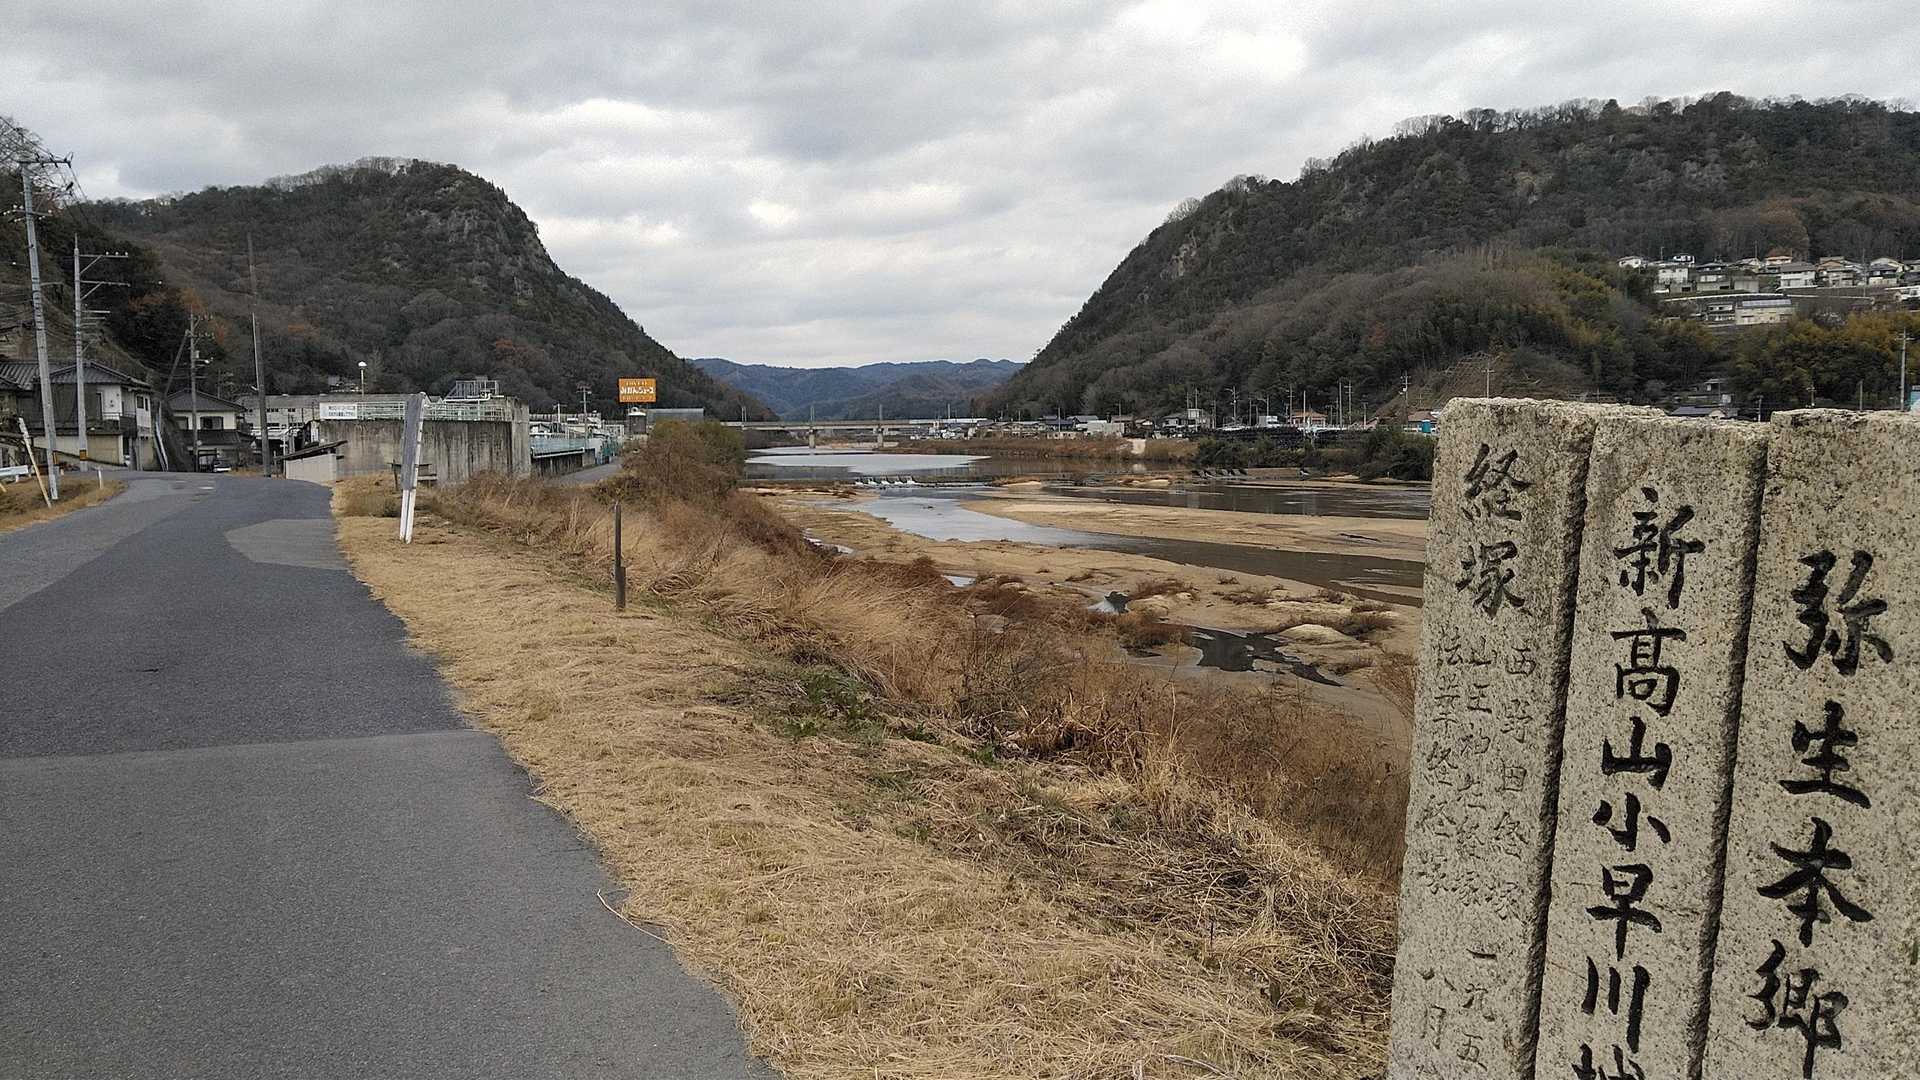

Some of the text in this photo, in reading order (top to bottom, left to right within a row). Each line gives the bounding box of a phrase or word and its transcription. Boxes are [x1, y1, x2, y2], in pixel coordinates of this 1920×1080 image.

[1455, 442, 1530, 618] 経塚
[1742, 549, 1893, 1079] 弥生本郷
